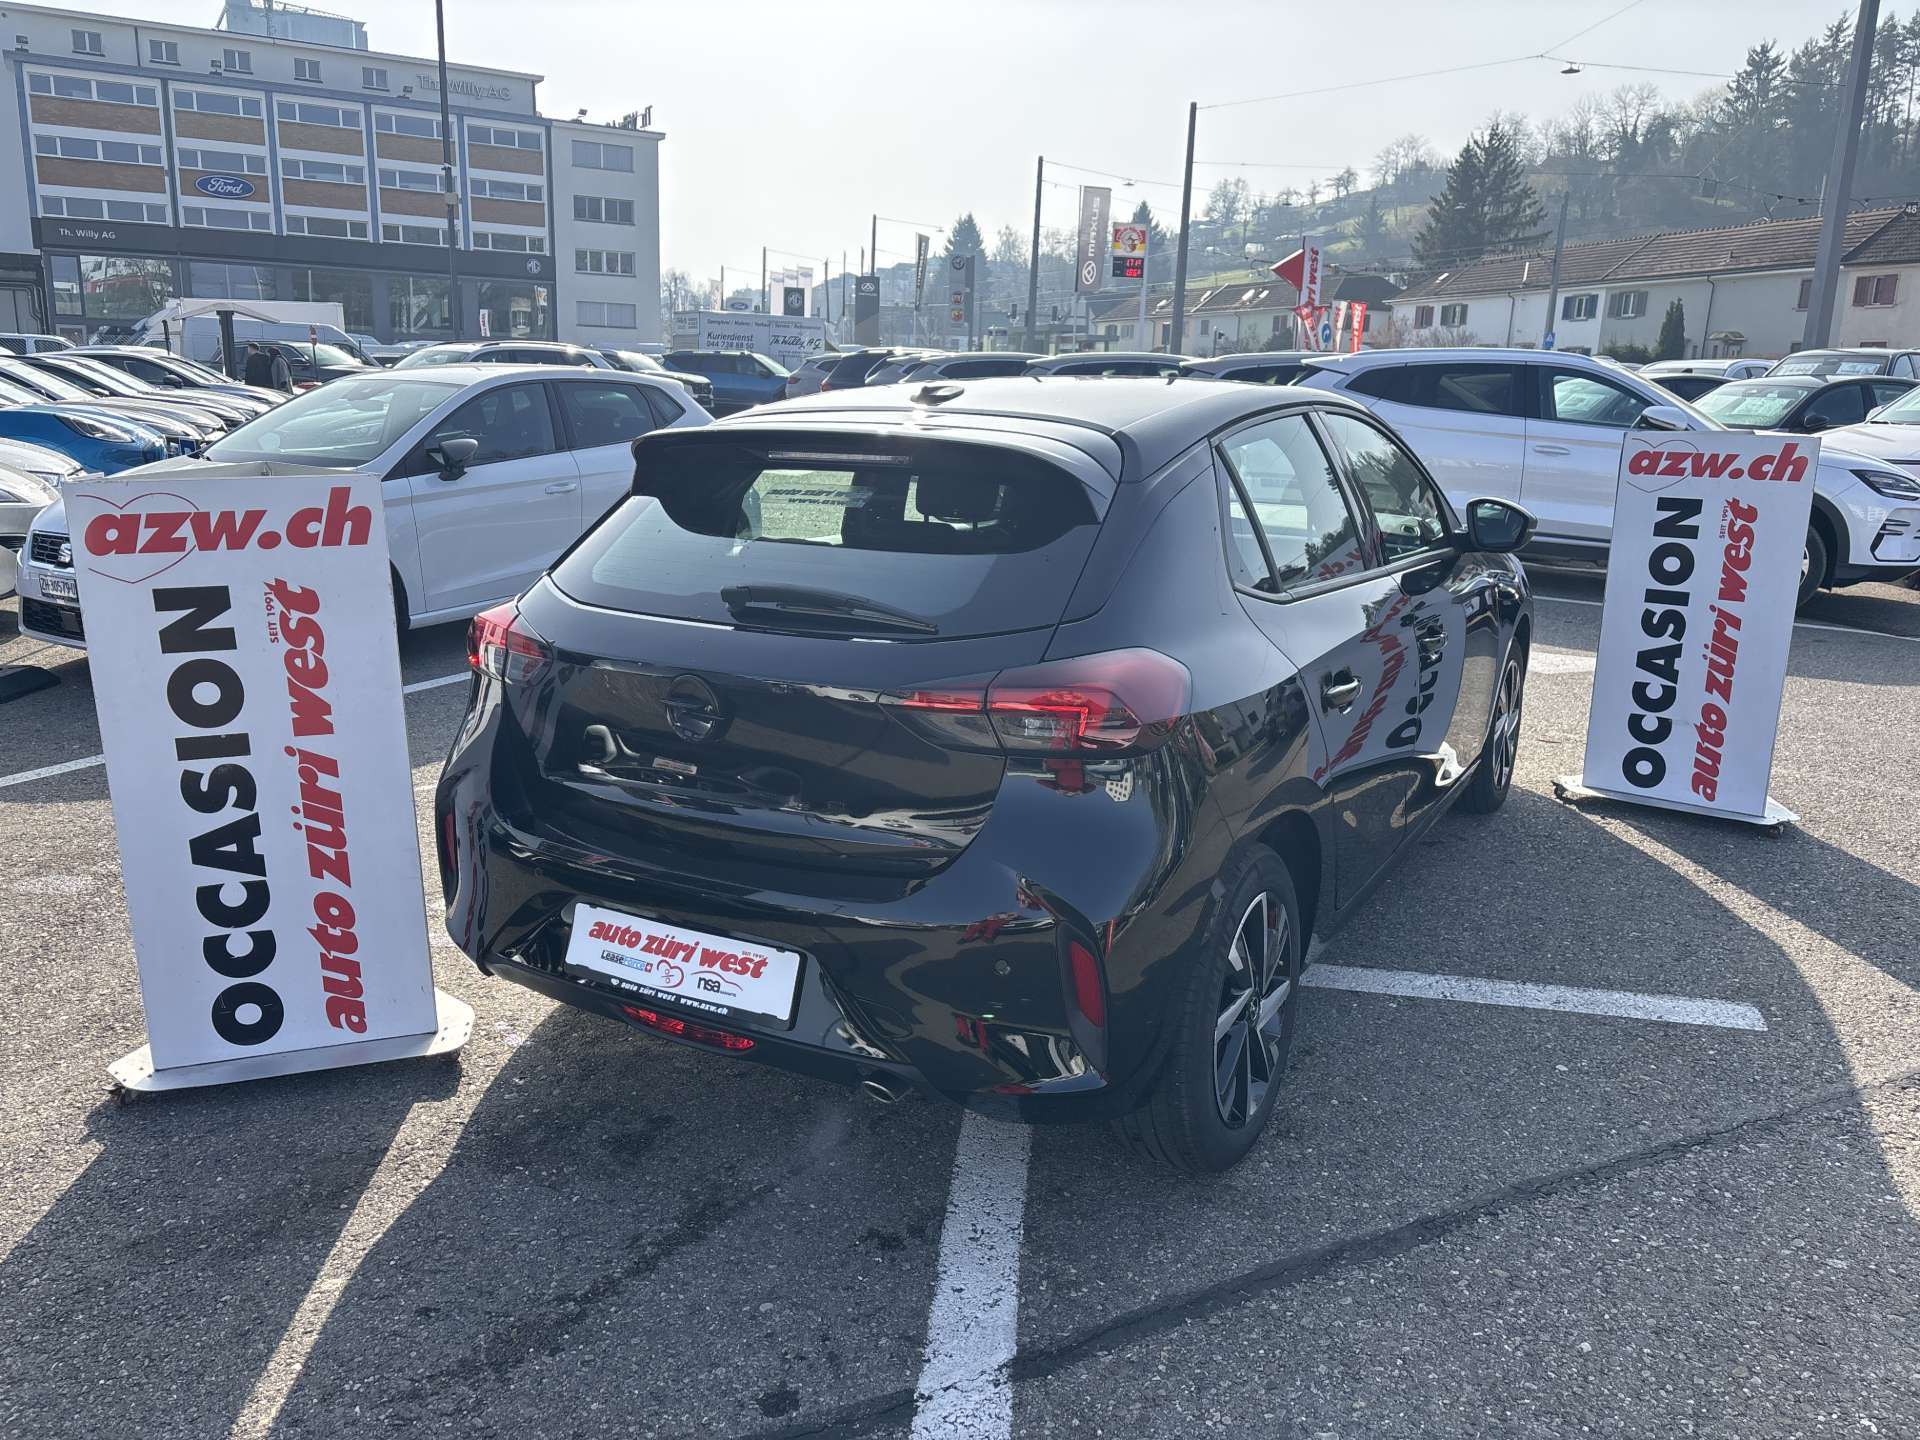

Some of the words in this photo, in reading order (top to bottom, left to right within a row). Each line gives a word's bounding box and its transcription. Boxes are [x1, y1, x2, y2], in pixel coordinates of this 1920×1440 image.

[487, 86, 512, 101] AG
[207, 177, 243, 194] Ford
[1905, 205, 1917, 214] 48
[59, 228, 73, 237] Th.
[75, 229, 99, 240] Willy
[101, 231, 116, 240] AG
[706, 331, 753, 342] Kurierdienst
[1629, 443, 1808, 483] azw.ch
[85, 487, 373, 557] azw.ch
[1721, 505, 1729, 522] 1991
[1719, 523, 1727, 539] SEIT
[1717, 497, 1760, 603] west
[263, 591, 276, 617] 1991
[267, 620, 280, 644] SEIT
[1622, 497, 1704, 789] OCCASION
[263, 578, 335, 737] west
[1703, 604, 1742, 705] züri
[1692, 702, 1728, 803] auto
[152, 586, 285, 1047] OCCASION
[284, 745, 353, 890] züri
[589, 921, 642, 949] auto
[640, 934, 700, 964] züri
[699, 947, 768, 979] west
[307, 903, 368, 1035] auto
[697, 976, 721, 994] nsa
[621, 982, 638, 992] auto
[639, 985, 657, 997] züri
[657, 991, 677, 1003] west
